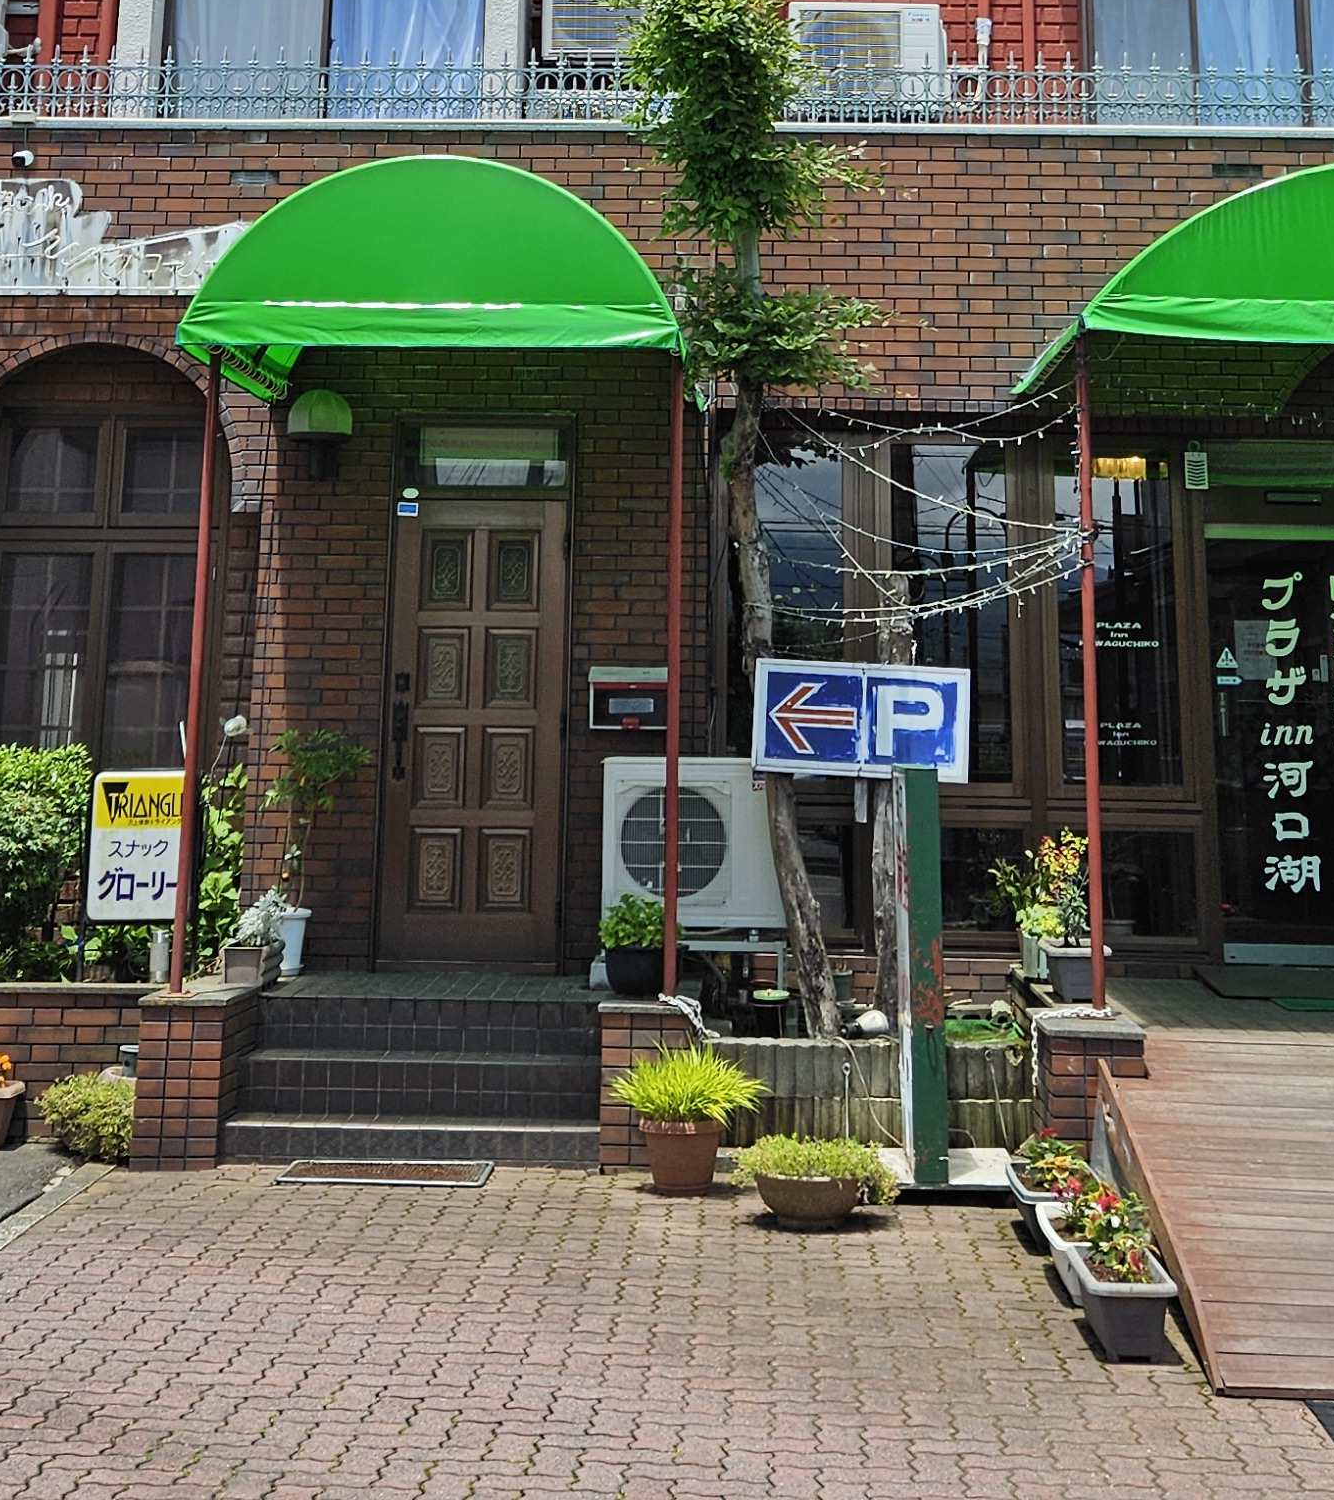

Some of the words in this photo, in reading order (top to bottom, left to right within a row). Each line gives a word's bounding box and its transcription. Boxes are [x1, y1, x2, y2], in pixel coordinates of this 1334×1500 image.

[876, 685, 944, 756] P
[108, 839, 169, 858] スナック
[97, 866, 178, 901] グローリー
